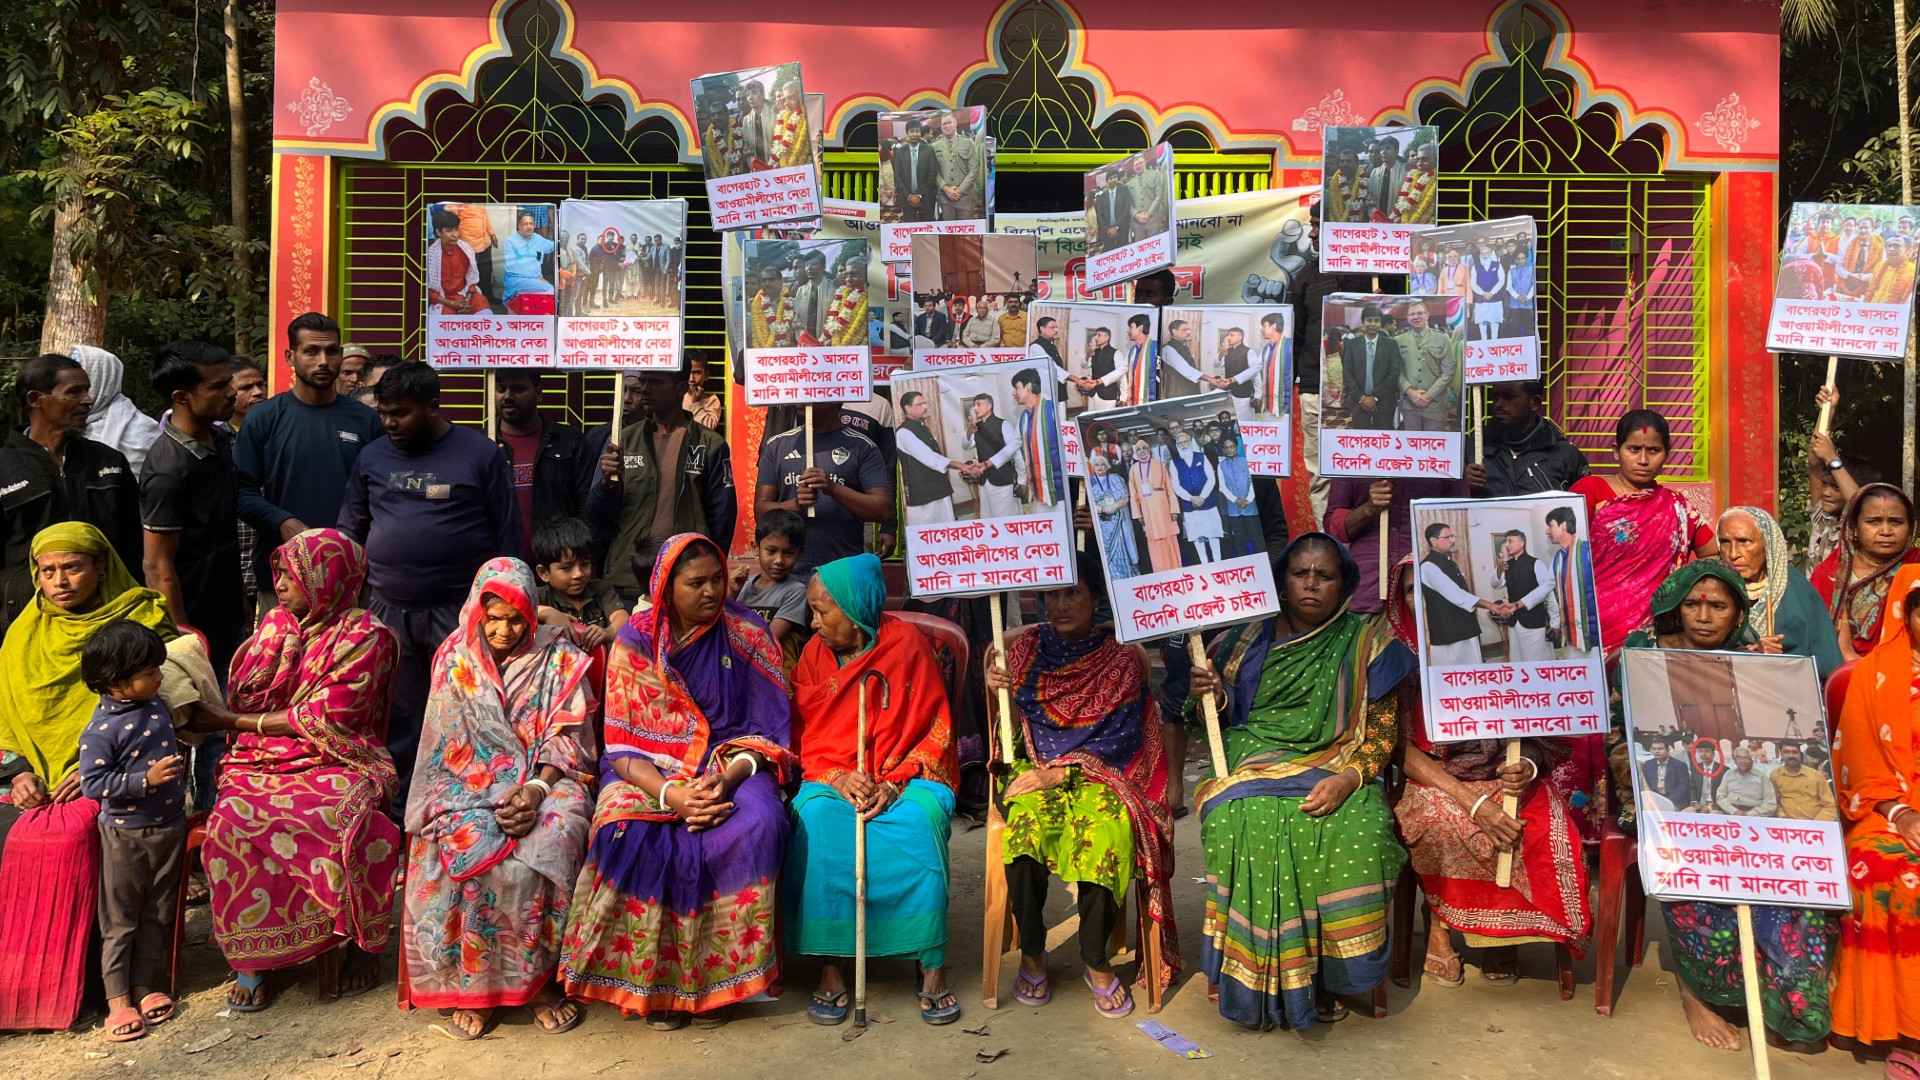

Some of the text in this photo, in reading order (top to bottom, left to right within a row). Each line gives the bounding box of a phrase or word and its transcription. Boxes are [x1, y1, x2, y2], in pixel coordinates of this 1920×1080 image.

[717, 173, 806, 193] বাগেরহাট ১ আসনে
[716, 188, 810, 210] আওয়ামীলীগের নেতা
[716, 201, 815, 224] মানি না মানবো না
[1226, 214, 1244, 227] না
[1332, 228, 1379, 240] বাগেরহাট
[1327, 256, 1353, 268] মানি
[1356, 258, 1368, 268] না
[1786, 303, 1900, 320] বাগেরহাট ১ আসনে
[438, 318, 545, 332] বাগেরহাট ১ আসনে
[567, 319, 670, 332] বাগেরহাট ১ আসনে
[1779, 319, 1899, 337] আওয়ামীলীগের নেতা
[436, 335, 549, 349] আওয়ামীলীগের নেতা
[563, 335, 672, 349] আওয়ামীলীগের নেতা
[1775, 332, 1899, 351] মানি না মানবো না
[434, 351, 551, 366] মানি না মানবো না
[560, 351, 673, 365] মানি না মানবো না
[757, 352, 860, 367] বাগেরহাট ১ আসনে
[924, 352, 977, 366] বাগেরহাট
[980, 354, 987, 363] ১
[1476, 347, 1484, 359] ১
[1487, 344, 1523, 357] আসনে
[753, 367, 833, 384] আওয়ামীলীগের
[836, 370, 863, 381] নেতা
[1499, 361, 1528, 376] চাইনা
[752, 385, 865, 401] মানি না মানবো না
[1252, 443, 1281, 456] নেতা
[1337, 432, 1446, 450] বাগেরহাট ১ আসনে
[1266, 461, 1283, 473] না
[1332, 453, 1452, 472] বিদেশি এজেন্ট চাইনা
[919, 518, 1054, 544] বাগেরহাট ১ আসনে
[916, 542, 1060, 568] আওয়ামীলীগের নেতা
[916, 564, 1065, 591] মানি না মানবো না
[1133, 565, 1255, 602] বাগেরহাট ১ আসনে
[1132, 591, 1267, 632] বিদেশি এজেন্ট চাইনা
[1442, 664, 1588, 688] বাগেরহাট ১ আসনে
[1439, 689, 1595, 712] আওয়ামীলীগের নেতা
[1439, 714, 1600, 737] মানি না মানবো না
[1660, 820, 1825, 846] বাগেরহাট ১ আসনে
[1656, 844, 1833, 872] আওয়ামীলীগের নেতা
[1656, 868, 1839, 899] মানি না মানবো না
